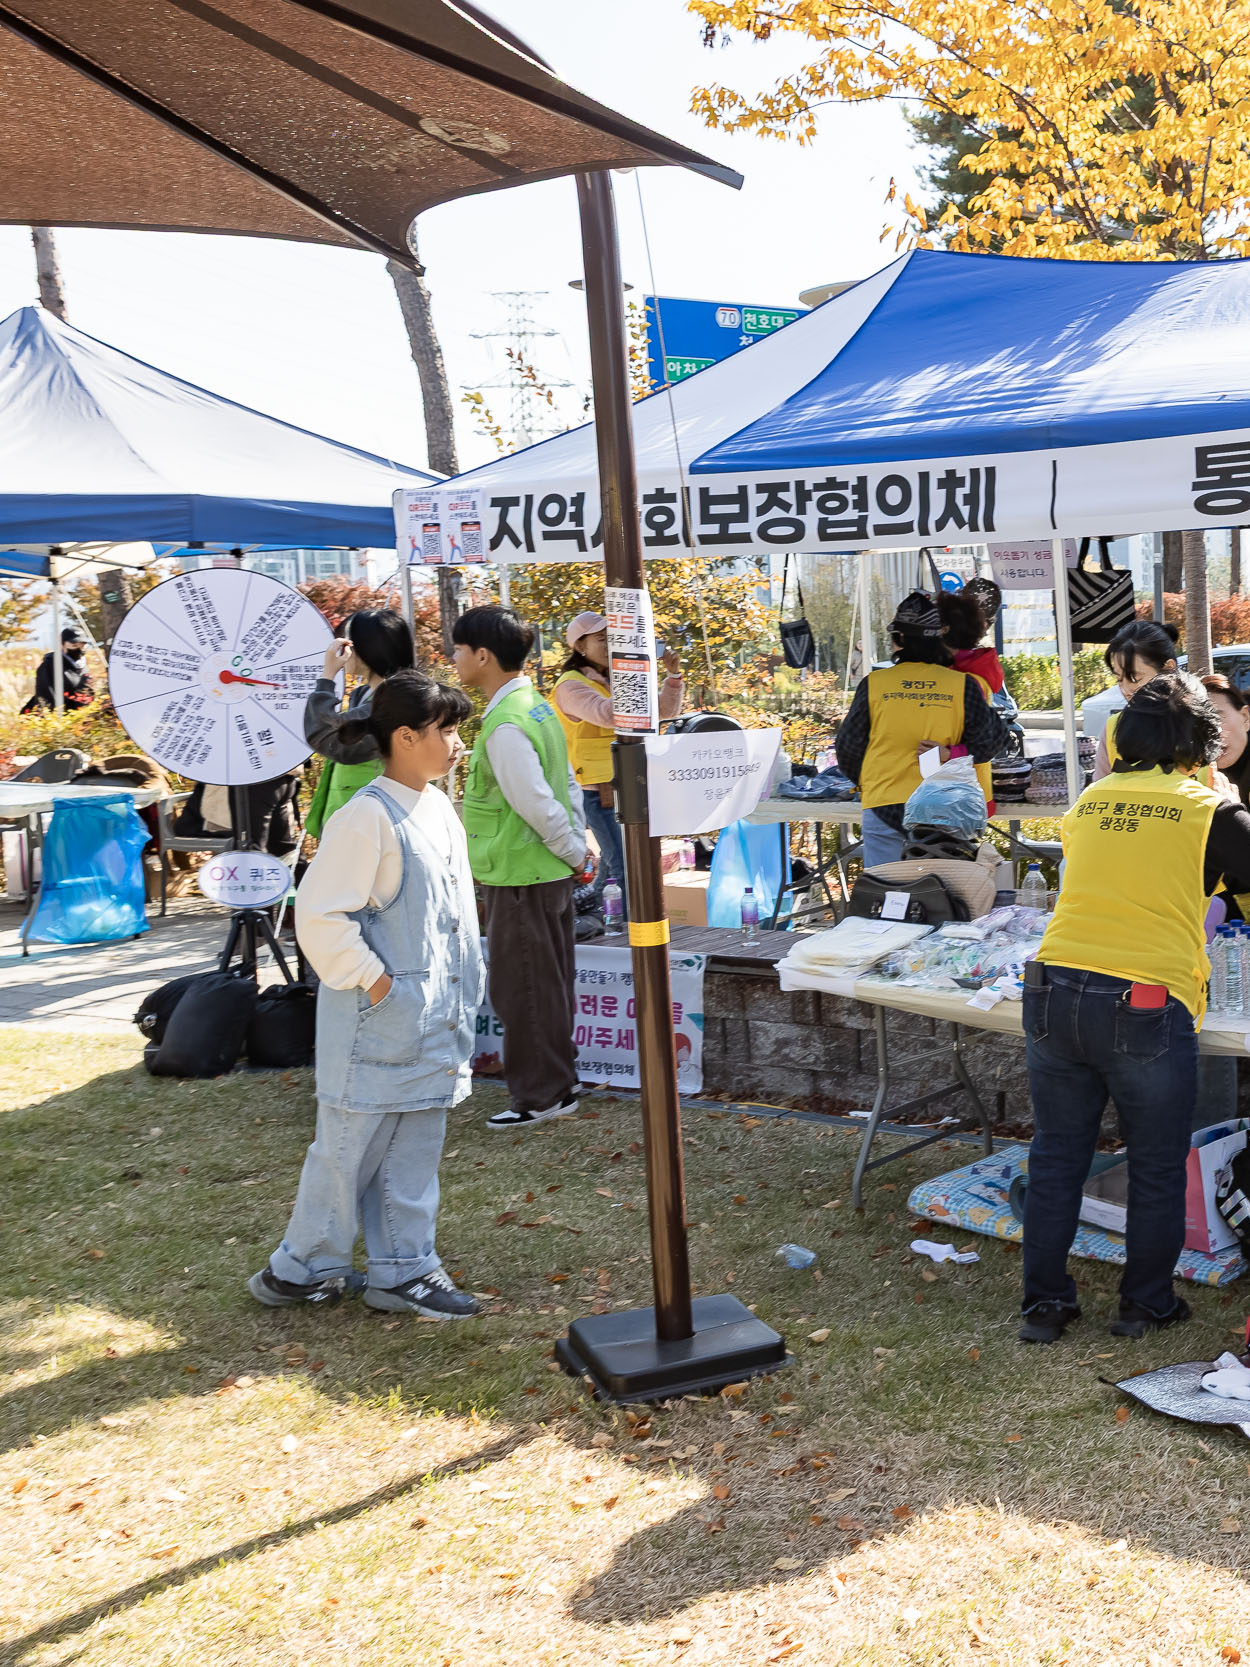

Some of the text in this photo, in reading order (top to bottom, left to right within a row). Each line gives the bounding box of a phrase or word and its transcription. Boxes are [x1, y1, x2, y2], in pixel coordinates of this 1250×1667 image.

[721, 312, 736, 324] 70
[745, 313, 796, 330] 천호대
[489, 466, 996, 553] 지역회보장협의체
[994, 550, 1072, 560] 이웃돕기 성금로
[932, 558, 972, 568] 전차량우선
[608, 615, 647, 634] 코드를
[608, 633, 648, 648] 해주세요
[901, 680, 936, 689] 광진구
[691, 747, 744, 760] 카카오뱅크
[1077, 802, 1183, 822] 광진구 통장협의회
[1100, 816, 1140, 832] 광장동
[210, 866, 281, 881] OX 퀴즈
[575, 1024, 635, 1050] 아주세
